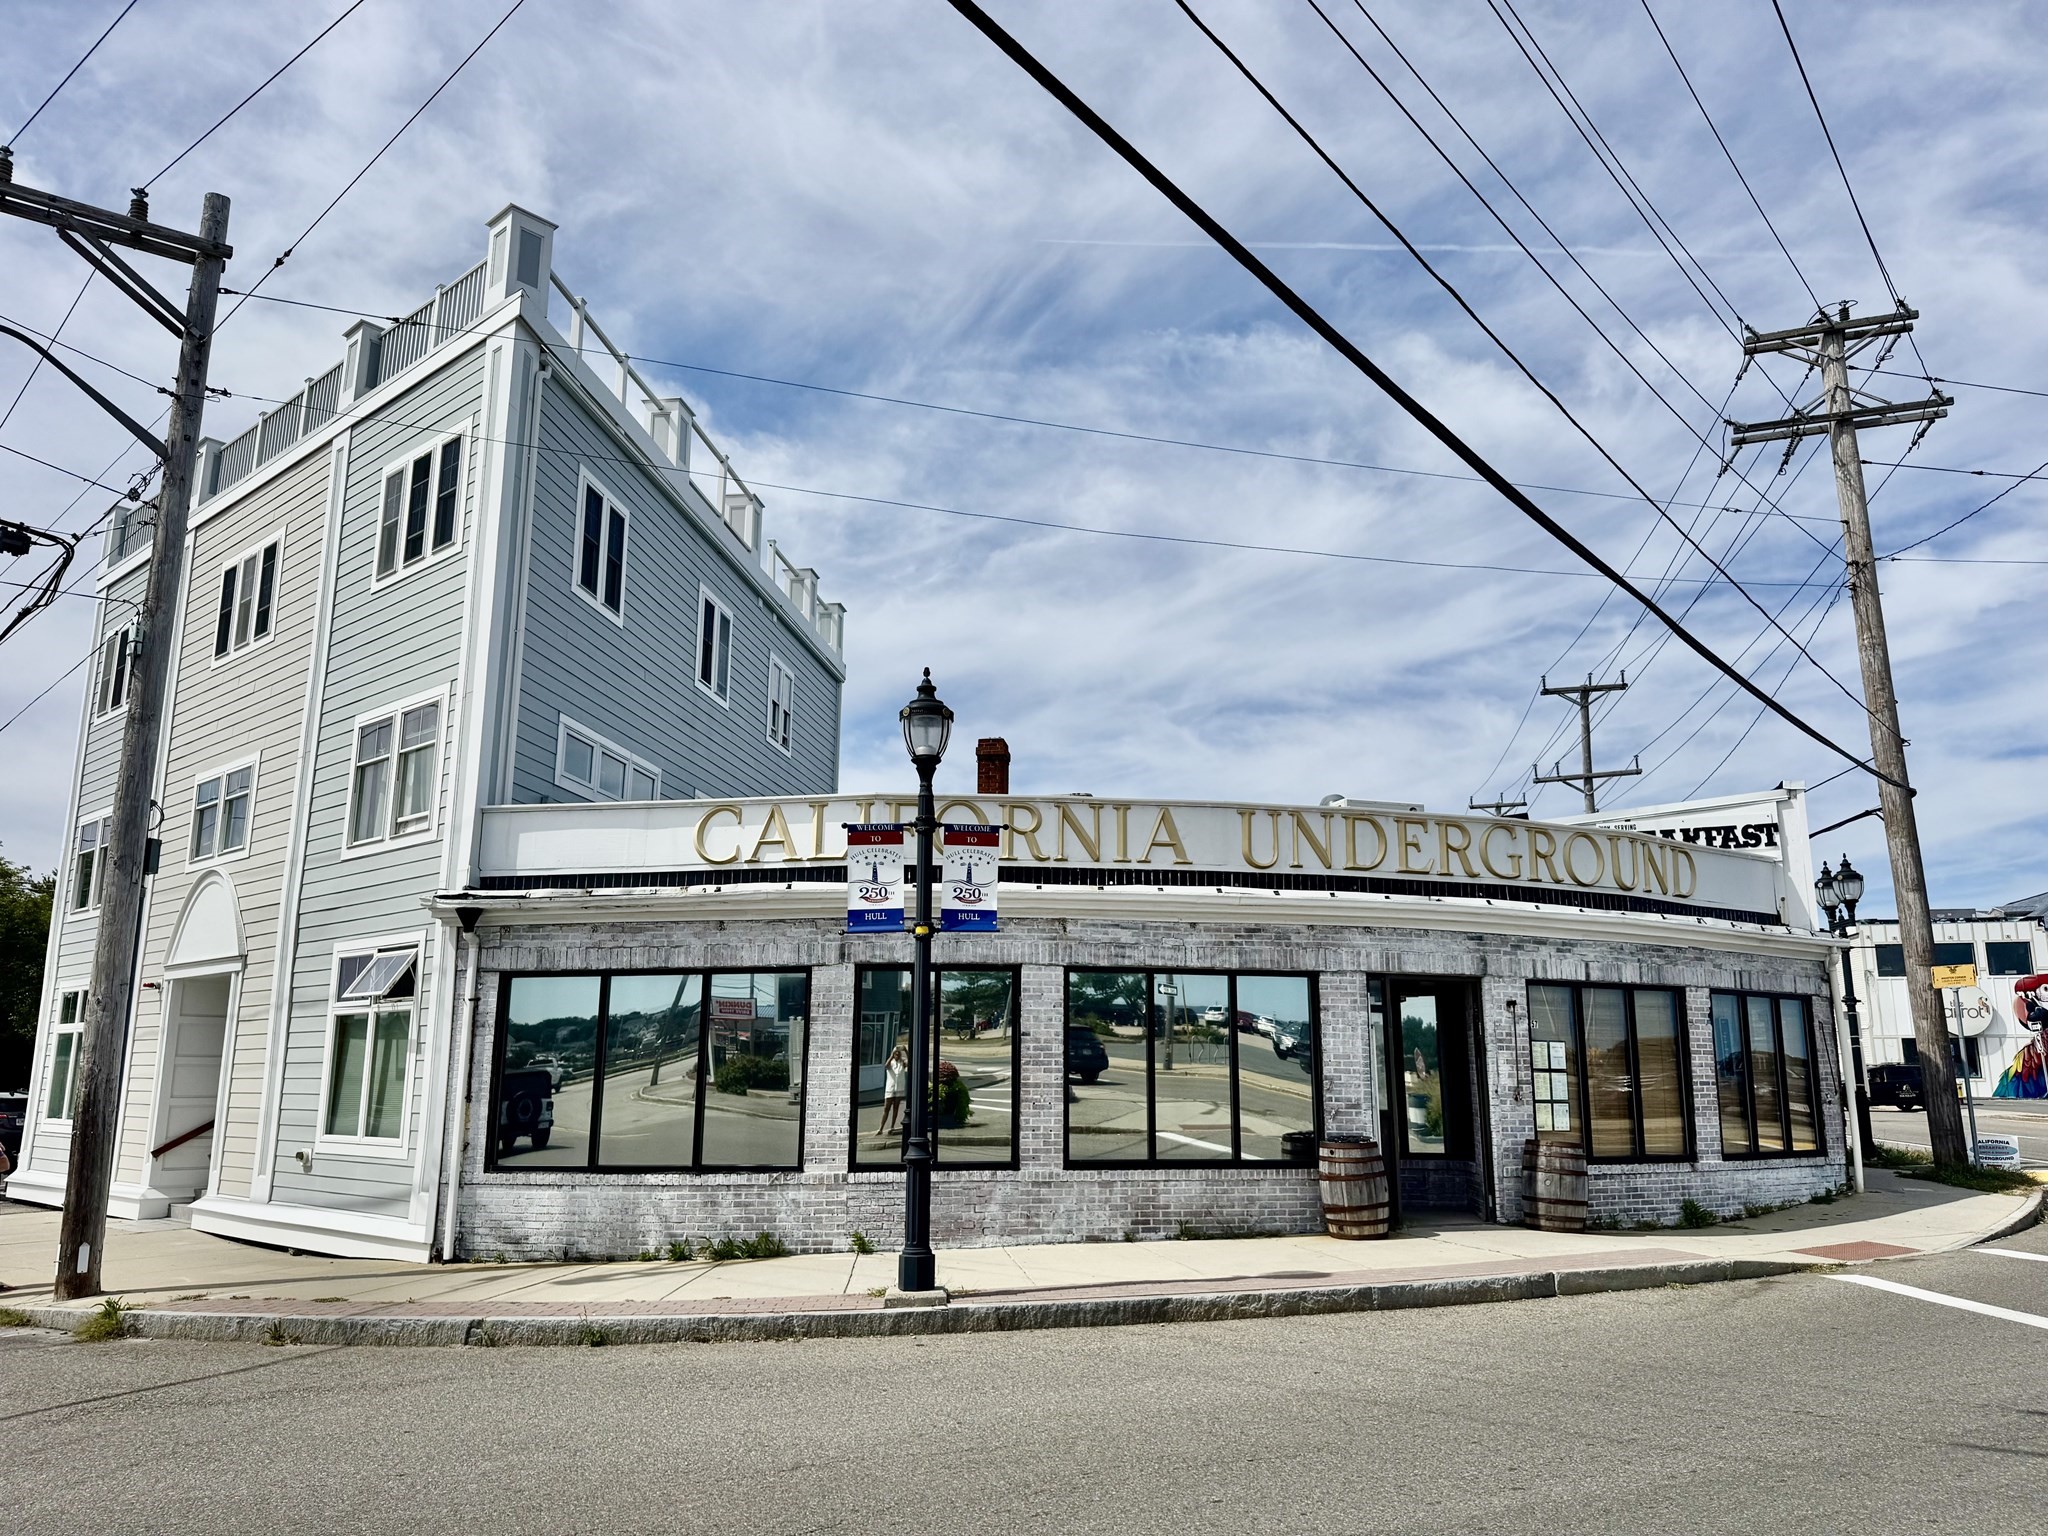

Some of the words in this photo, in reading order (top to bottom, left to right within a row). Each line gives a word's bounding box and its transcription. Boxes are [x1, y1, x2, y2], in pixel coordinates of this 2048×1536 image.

[966, 836, 978, 844] TO
[1637, 823, 1779, 850] KFAST
[850, 850, 865, 861] HULL
[866, 847, 902, 860] CELEBRATES
[945, 850, 961, 861] HULL
[961, 848, 997, 862] CELEBRATES
[1236, 809, 1698, 899] UNDERGROUND
[864, 912, 887, 920] HULL
[958, 913, 980, 921] HULL
[1950, 1000, 1964, 1008] te
[1944, 1005, 1985, 1019] arot
